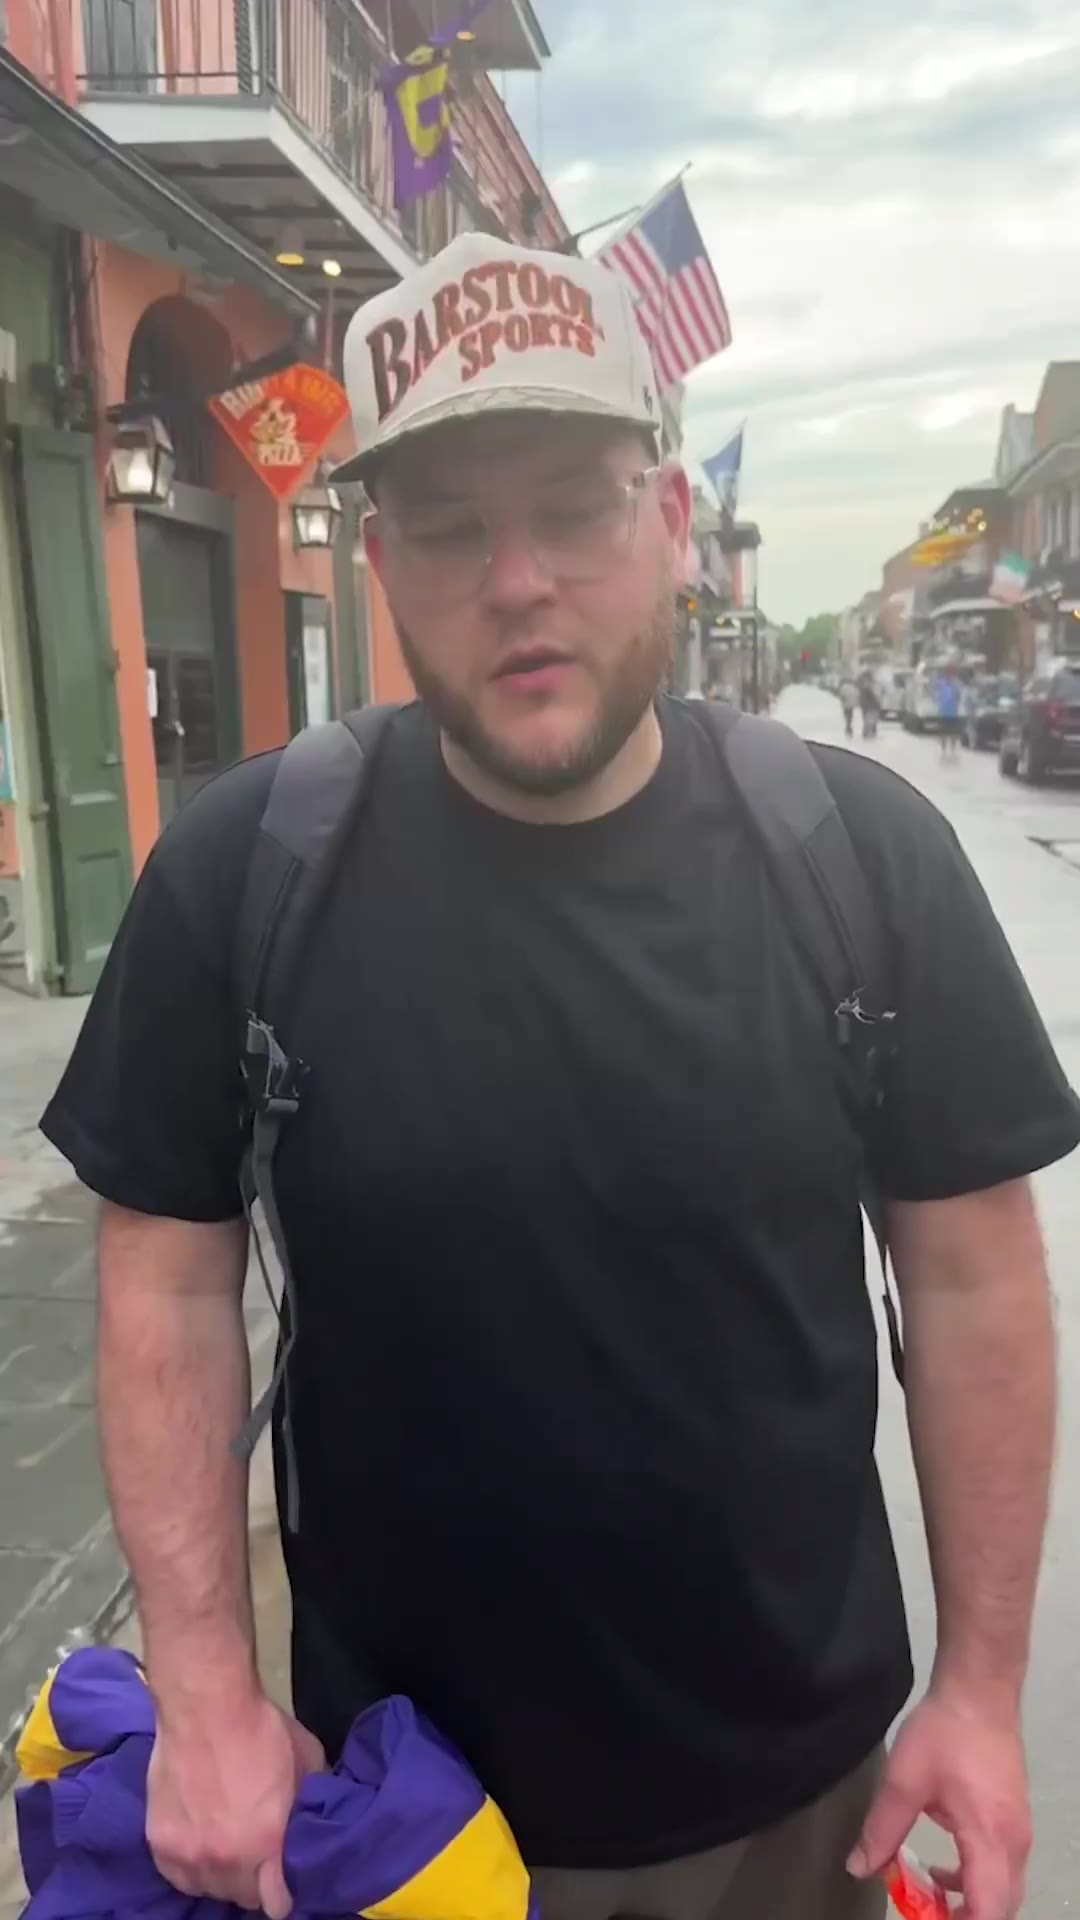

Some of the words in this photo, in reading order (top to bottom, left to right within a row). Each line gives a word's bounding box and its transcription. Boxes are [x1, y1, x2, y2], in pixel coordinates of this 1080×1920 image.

[365, 260, 604, 424] BARSTOOL
[458, 313, 595, 382] SPORTS
[257, 442, 304, 466] PIZZA
